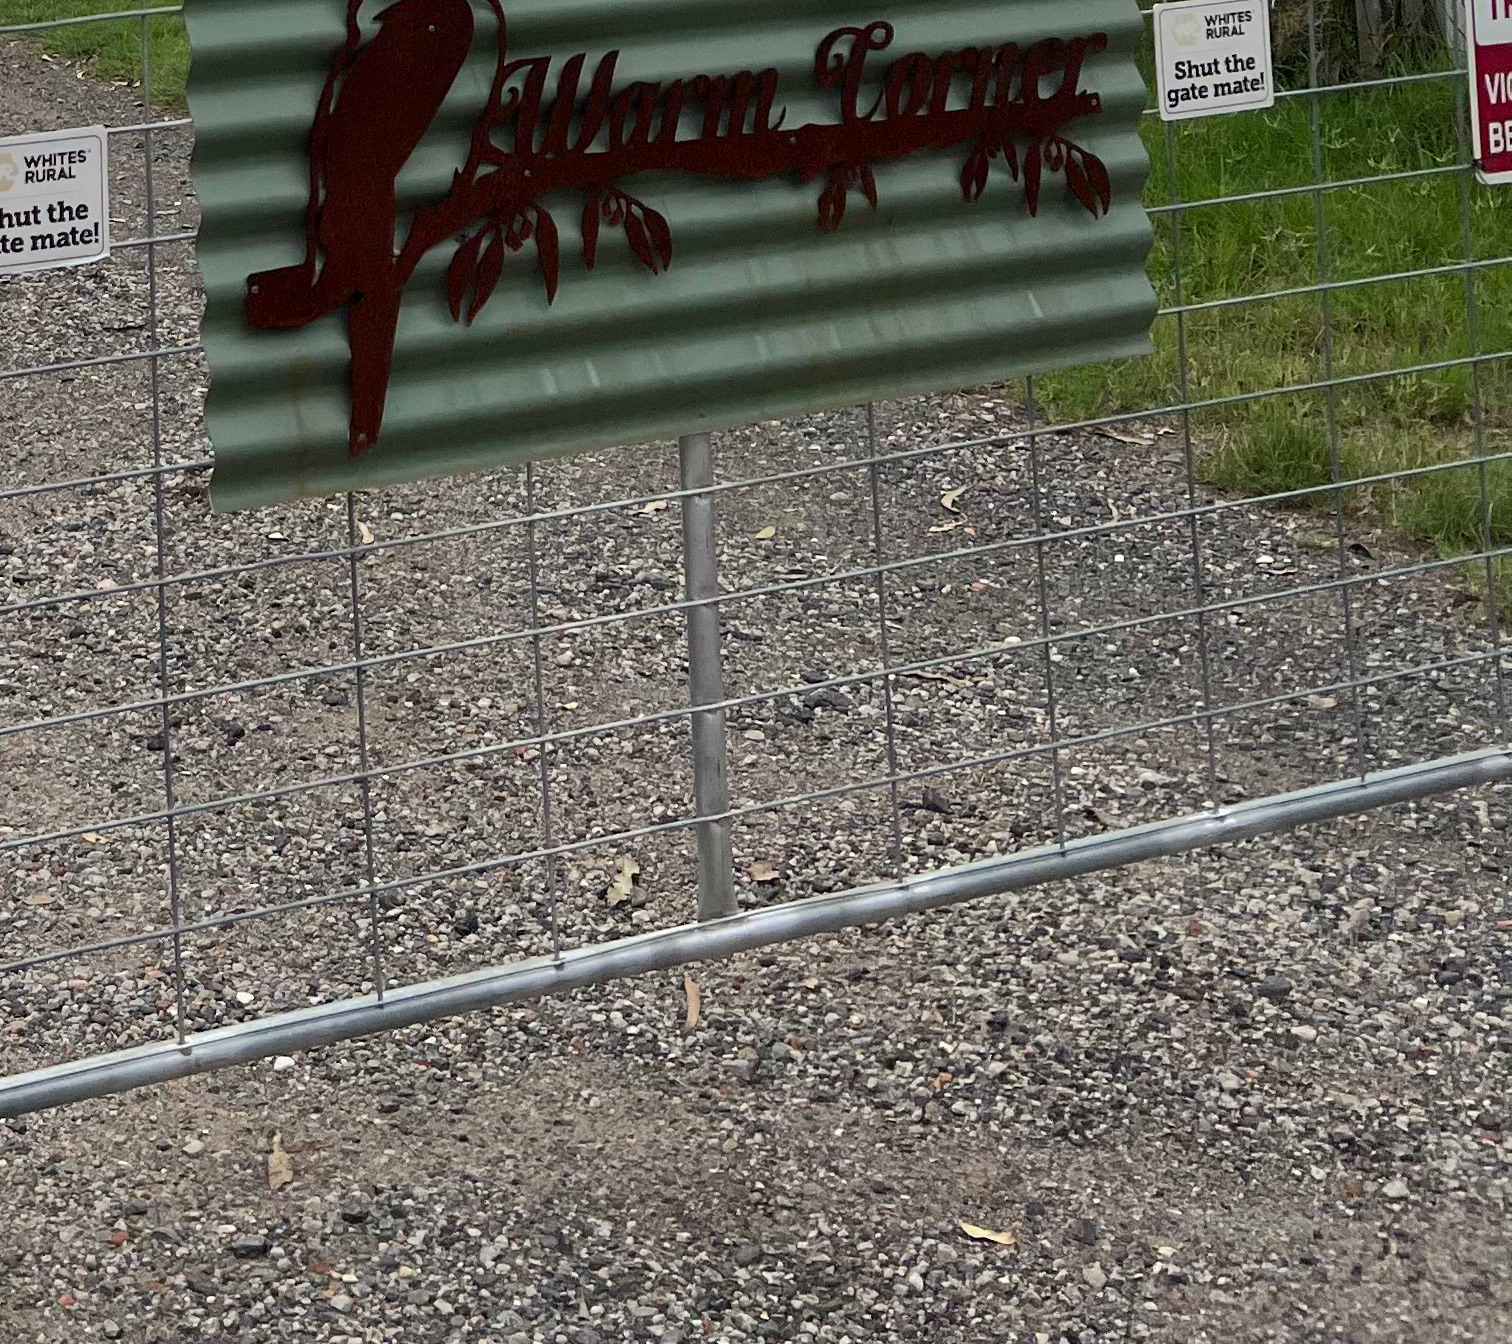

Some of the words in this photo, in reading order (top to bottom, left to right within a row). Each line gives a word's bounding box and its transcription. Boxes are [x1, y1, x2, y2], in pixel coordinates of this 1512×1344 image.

[1204, 11, 1253, 26] WHITES
[1206, 24, 1245, 40] RURAL
[1174, 58, 1221, 80] Shut
[1224, 54, 1256, 74] the
[497, 48, 787, 154] Warm
[814, 20, 1108, 124] Corner
[1167, 83, 1209, 108] gate
[1213, 72, 1265, 98] mate!
[24, 150, 87, 169] WHITES
[25, 166, 76, 184] RURAL
[47, 201, 89, 223] the
[30, 222, 100, 252] mate!
